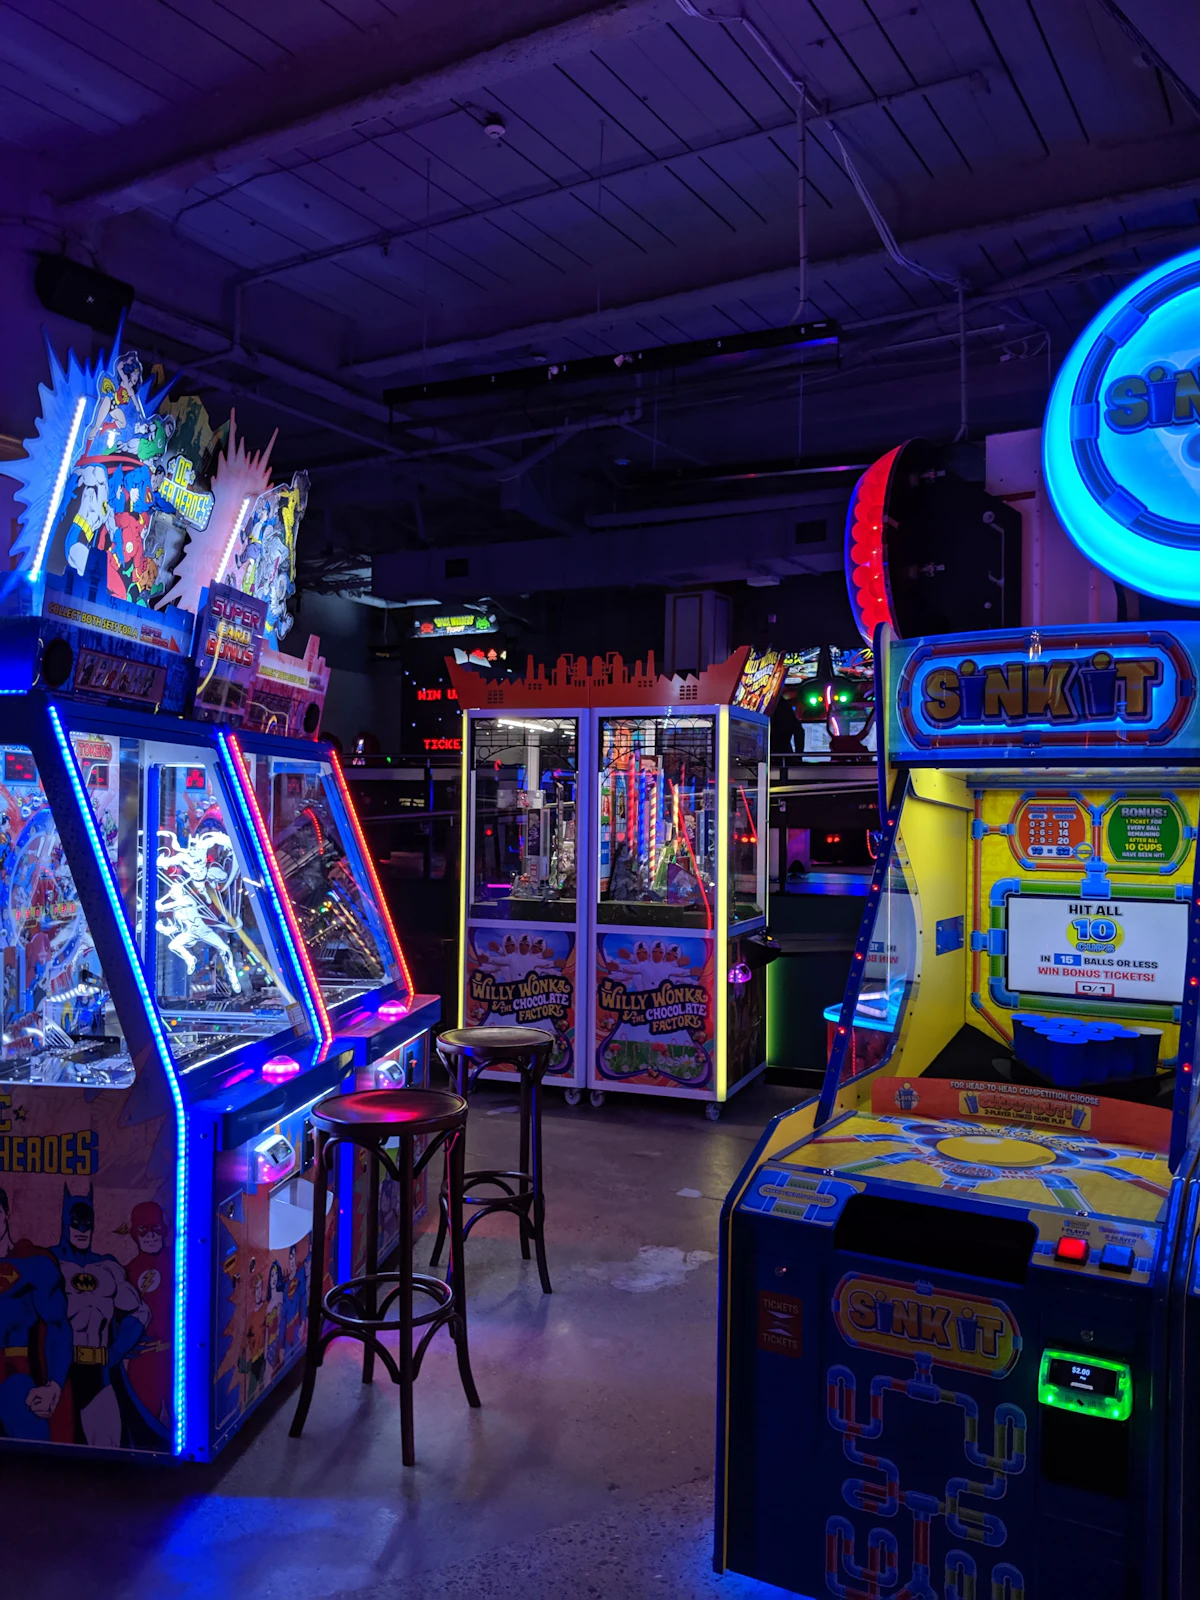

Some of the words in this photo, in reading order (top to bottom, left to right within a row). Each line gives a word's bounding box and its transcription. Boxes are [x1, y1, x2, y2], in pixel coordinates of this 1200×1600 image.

[175, 488, 209, 525] HEROES
[48, 602, 80, 622] COLLECT
[81, 612, 101, 628] BOTH
[102, 618, 118, 632] SETS
[119, 624, 131, 637] FOR
[212, 596, 260, 631] SUPER
[205, 630, 256, 667] BONUS
[417, 690, 442, 700] WIN
[78, 743, 111, 758] TOKENS
[1122, 808, 1167, 818] BONUS:
[1069, 904, 1092, 915] HIT
[1096, 906, 1123, 916] ALL
[1072, 918, 1117, 942] 10
[1076, 942, 1116, 953] CUPS
[1040, 955, 1051, 963] IN
[1060, 956, 1074, 964] 15
[1084, 958, 1114, 967] BALLS
[1116, 960, 1130, 968] OR
[1133, 961, 1158, 969] LESS
[1038, 966, 1060, 976] WIN
[1062, 968, 1100, 978] BONUS
[1104, 970, 1155, 982] TICKETS!
[472, 977, 515, 1000] WILLY
[518, 974, 570, 998] WONKA
[1082, 984, 1106, 993] 0/1
[513, 993, 569, 1010] CHOCOLATE
[601, 986, 648, 1010] WILLY
[651, 982, 708, 1008] WONKA
[519, 1004, 564, 1021] FACTORY
[646, 1002, 707, 1020] CHOCOLATE
[652, 1015, 701, 1032] FACTORY
[950, 1081, 965, 1090] FOR
[966, 1082, 1018, 1094] HEAD-TO-HEAD
[1020, 1086, 1068, 1100] COMPETITION
[1070, 1093, 1100, 1106] CHOOSE
[978, 1092, 1073, 1120] SHOOTOUT!
[984, 1110, 1011, 1118] 2-PLAYER
[1012, 1112, 1033, 1120] LINKED
[1034, 1114, 1050, 1123] GAME
[1051, 1117, 1066, 1126] PLAY
[1061, 1227, 1090, 1236] 1-PLAYER
[1105, 1234, 1136, 1244] 2-PLAYER
[764, 1298, 799, 1314] TICKETS
[762, 1332, 798, 1350] TICKETS
[1072, 1366, 1090, 1376] $2.00
